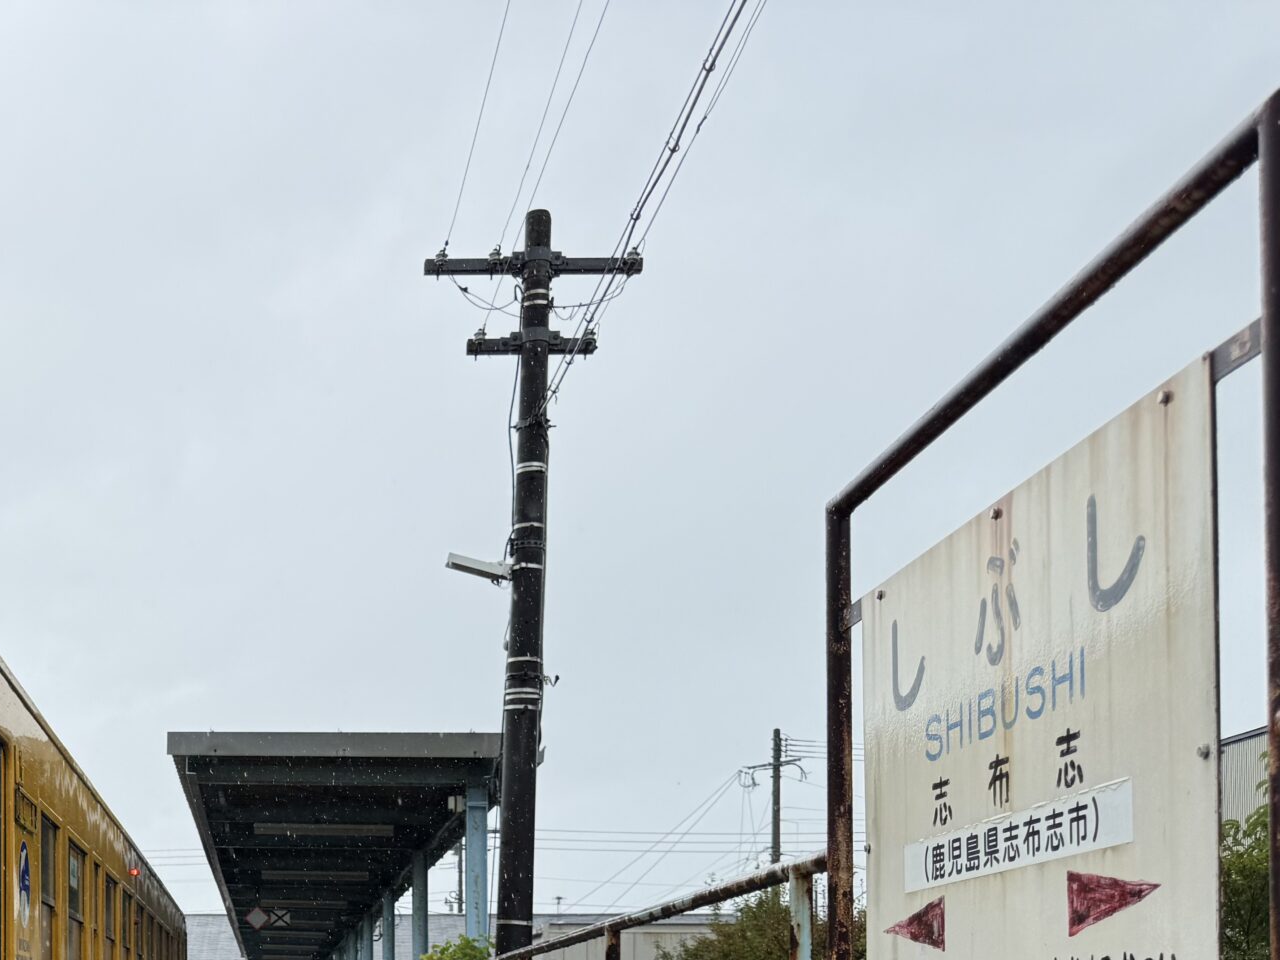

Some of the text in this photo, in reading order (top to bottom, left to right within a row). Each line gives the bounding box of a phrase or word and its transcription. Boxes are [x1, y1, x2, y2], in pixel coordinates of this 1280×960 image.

[891, 493, 1146, 712] しぶし
[925, 645, 1086, 762] SHIBUSHI
[931, 727, 1084, 828] 志布志
[924, 796, 1099, 883] (鹿児島県志布志市)
